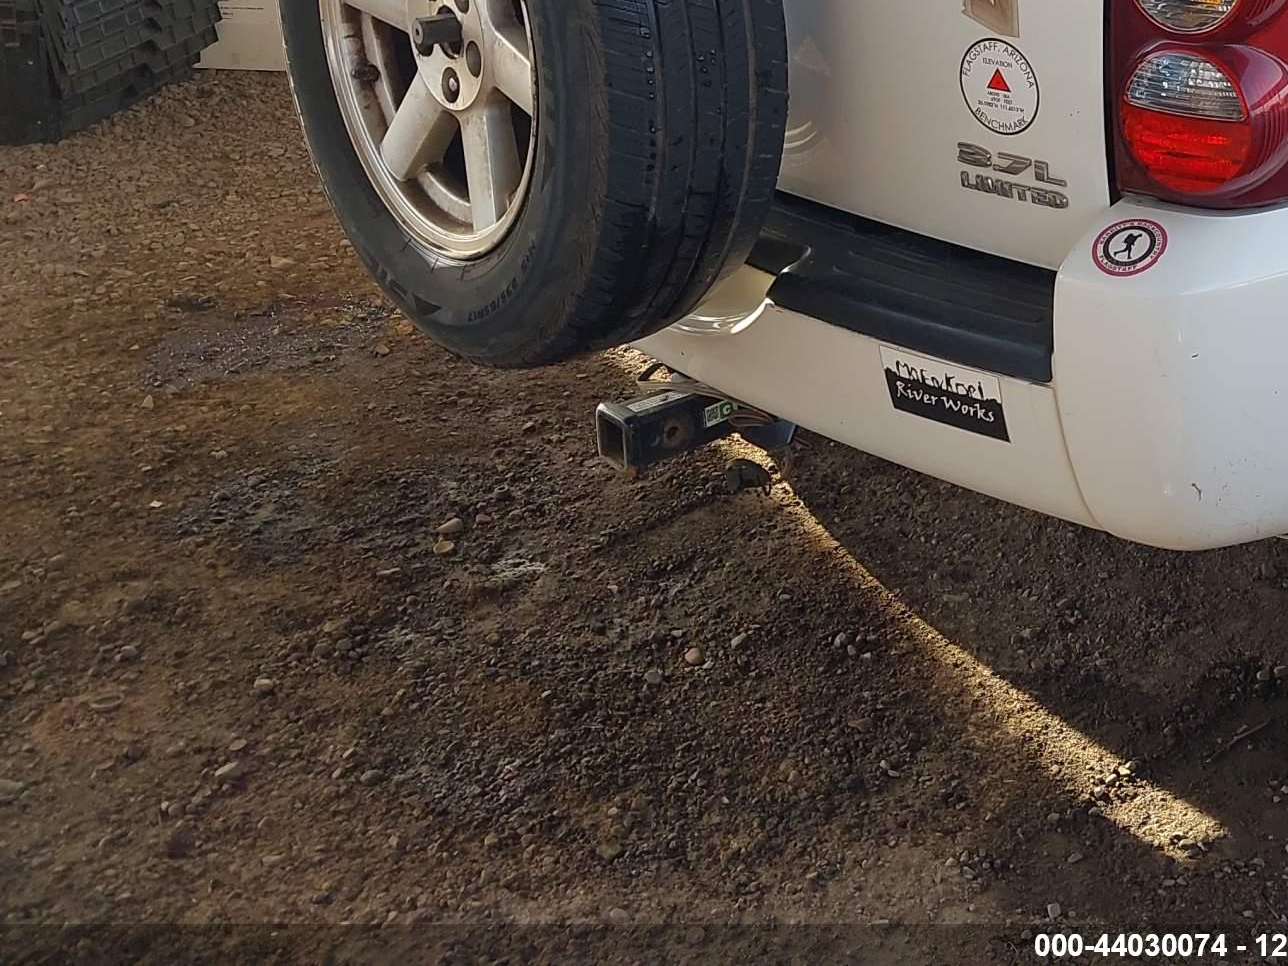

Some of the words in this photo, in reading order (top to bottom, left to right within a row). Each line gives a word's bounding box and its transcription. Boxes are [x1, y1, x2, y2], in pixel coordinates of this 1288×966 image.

[962, 41, 1001, 77] FLAGSTAFF,
[1002, 46, 1035, 89] ARIZONA
[974, 106, 1029, 132] BENCHMARK
[960, 170, 1069, 209] LIMITED
[895, 380, 938, 406] River
[940, 395, 994, 422] Works
